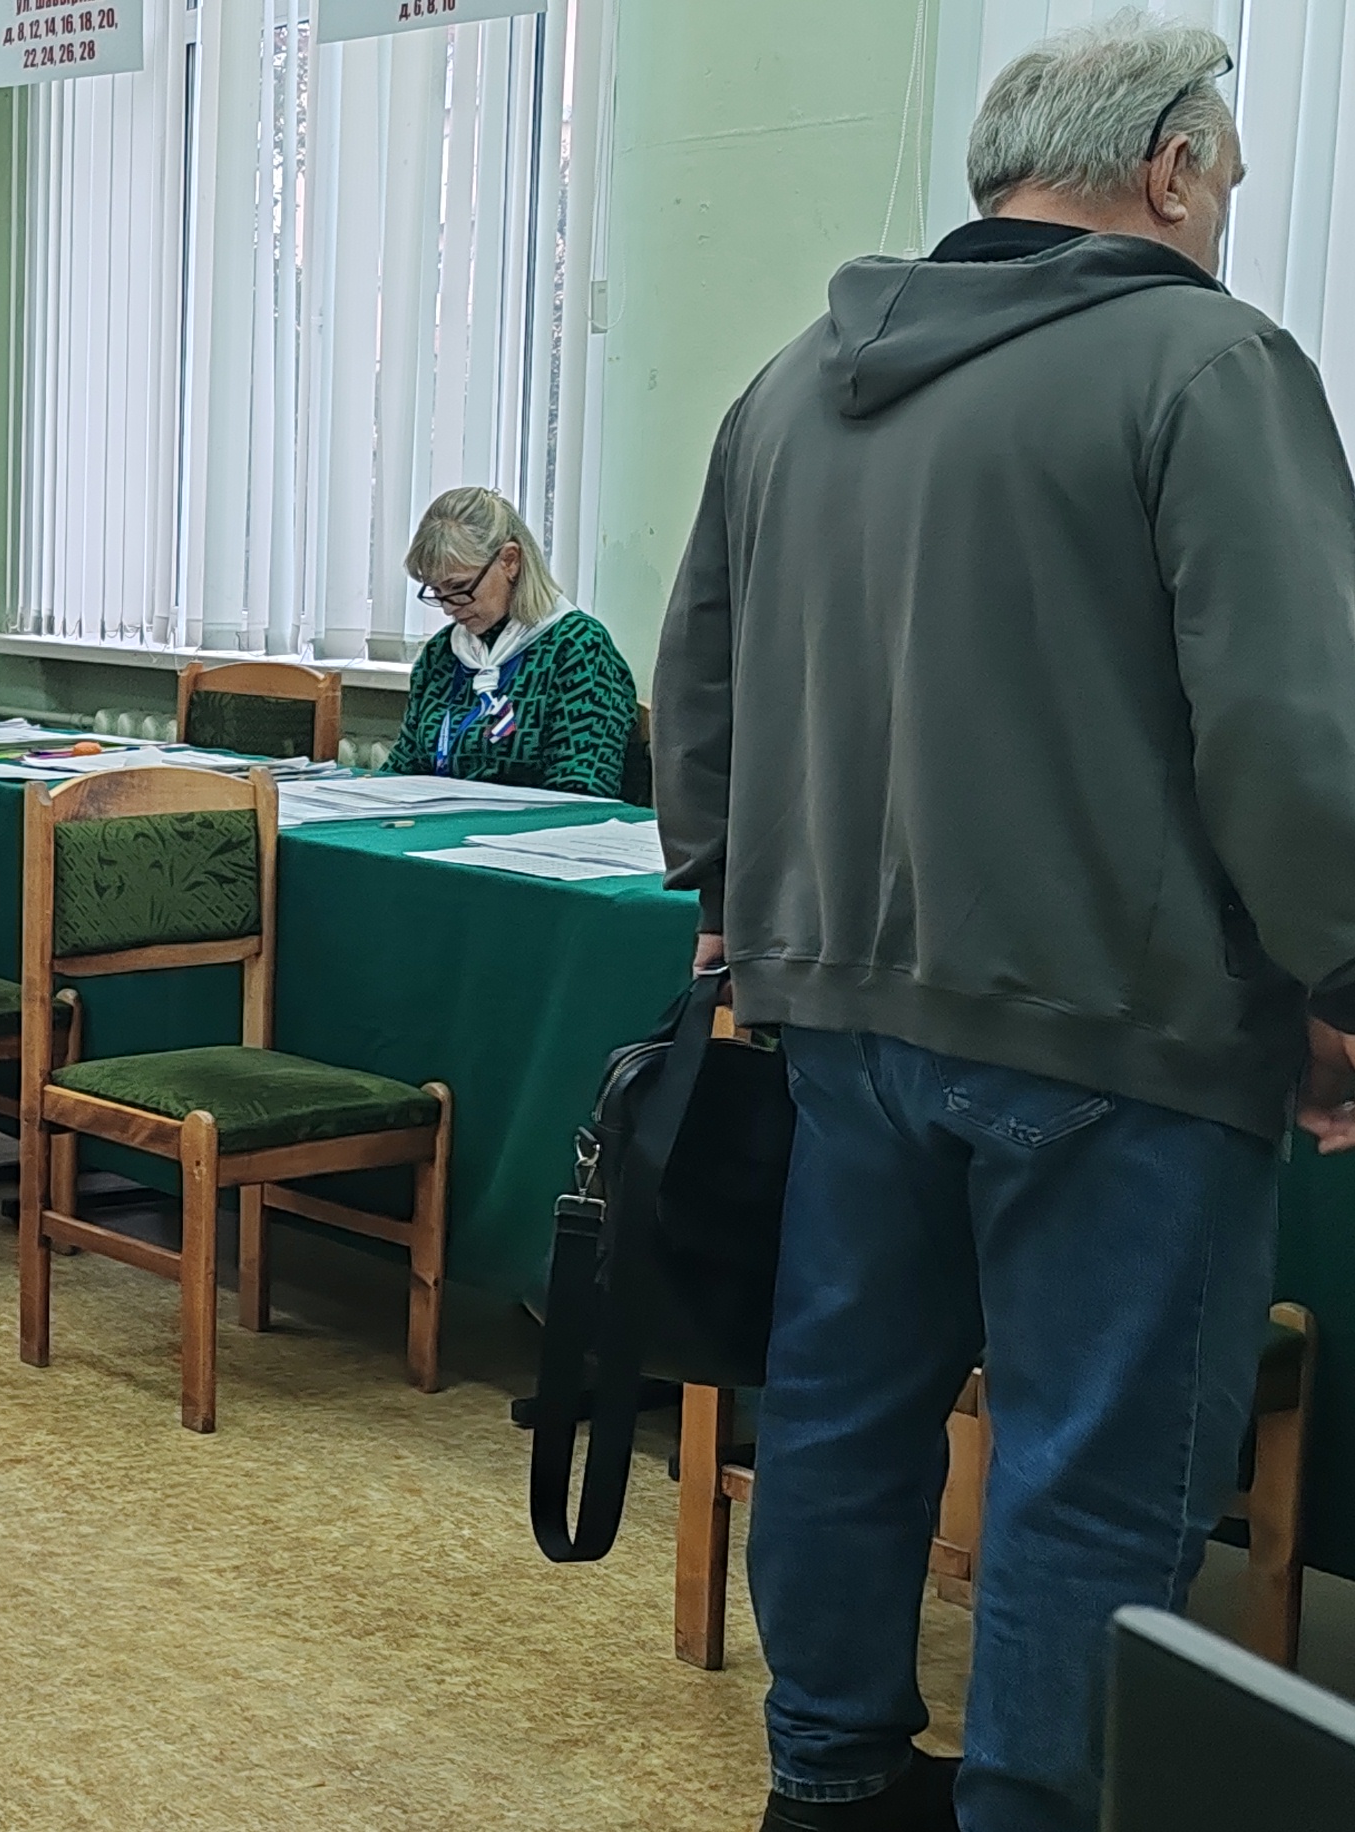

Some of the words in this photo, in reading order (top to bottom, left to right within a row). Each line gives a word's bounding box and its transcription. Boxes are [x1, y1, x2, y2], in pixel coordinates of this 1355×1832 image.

[398, 3, 411, 21] д.
[3, 27, 15, 46] д.
[17, 22, 27, 42] 8,
[29, 19, 42, 39] 12,
[44, 17, 58, 37] 14,
[61, 14, 76, 35] 16,
[79, 11, 96, 32] 18,
[98, 8, 118, 30] 20,
[23, 48, 39, 69] 22,
[40, 45, 56, 66] 24,
[59, 43, 77, 64] 26,
[79, 40, 96, 61] 28
